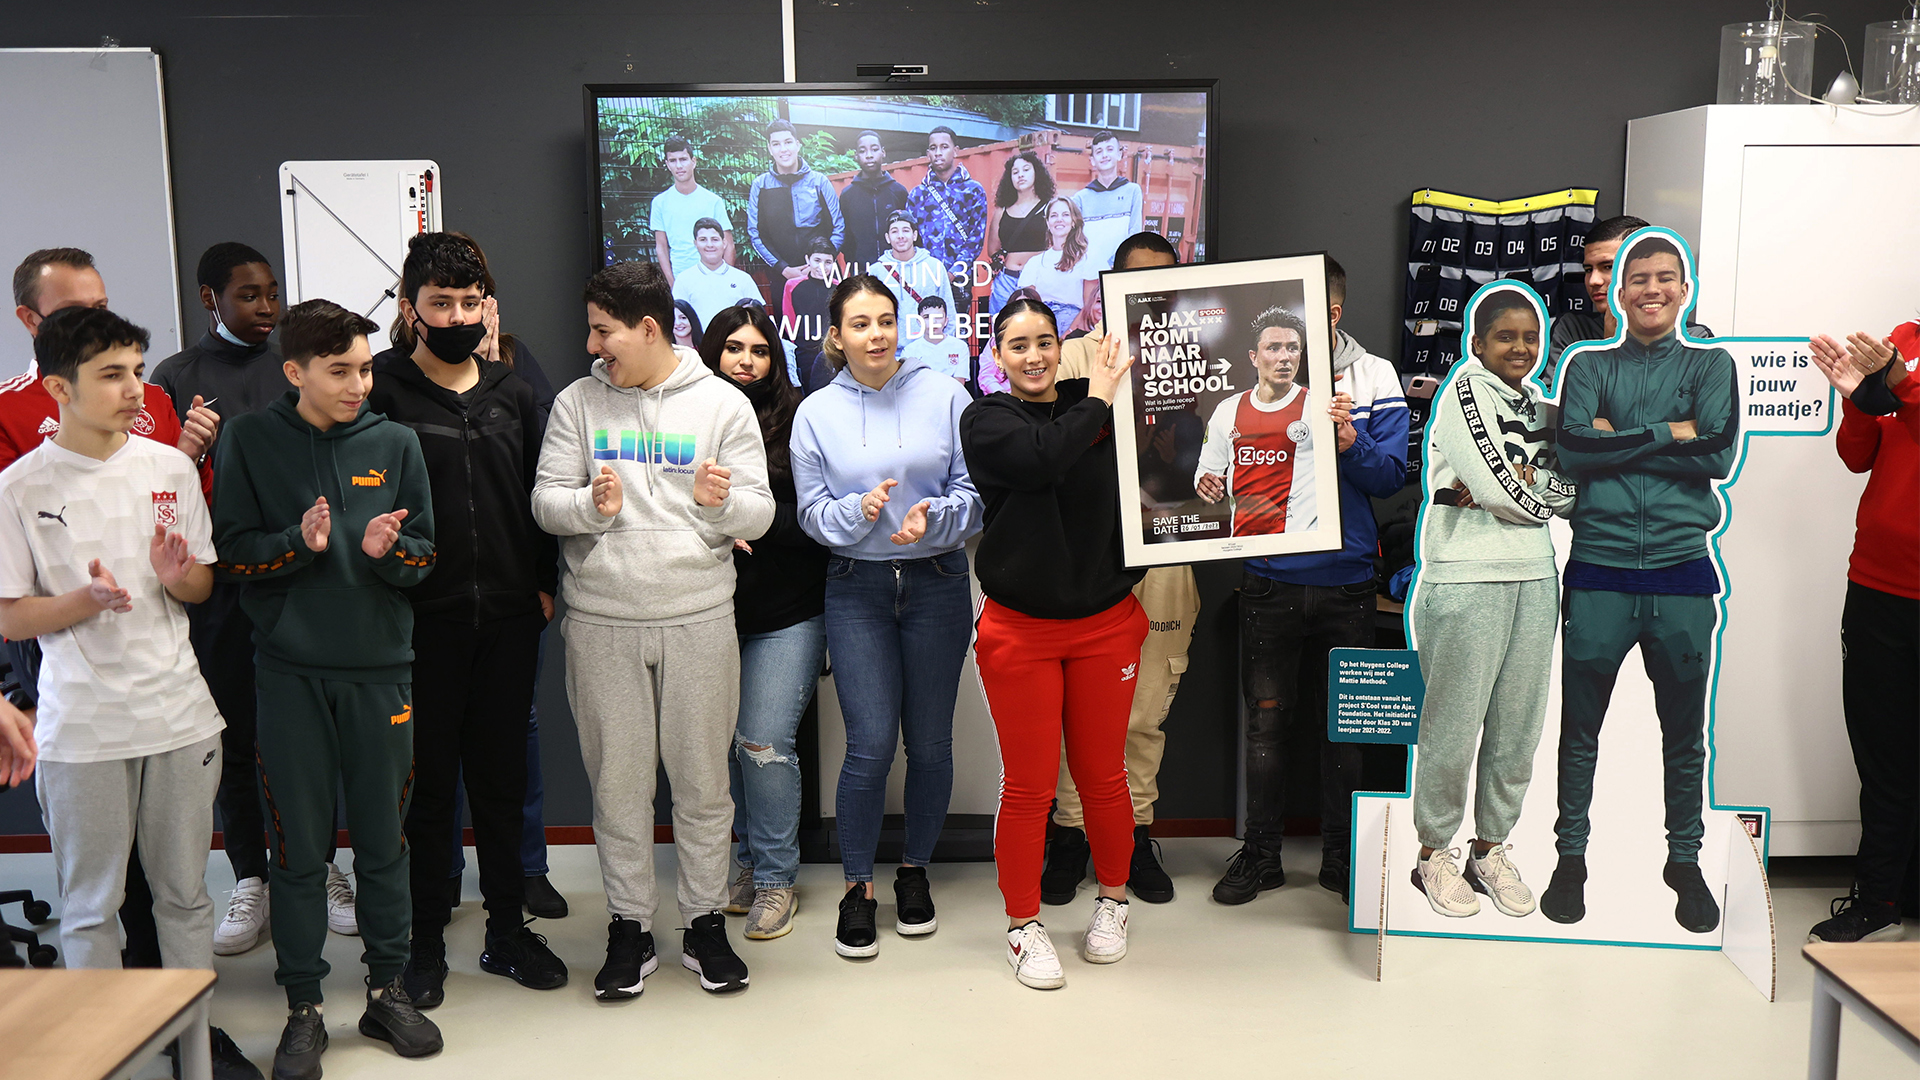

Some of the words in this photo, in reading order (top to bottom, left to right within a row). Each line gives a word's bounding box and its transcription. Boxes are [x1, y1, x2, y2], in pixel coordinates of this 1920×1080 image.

[1422, 240, 1436, 254] 01
[1442, 238, 1460, 252] 02
[1474, 241, 1493, 256] 03
[1507, 240, 1524, 254] 04
[1541, 236, 1558, 252] 05
[882, 261, 942, 288] ZIJN
[952, 260, 993, 288] 3D
[1414, 301, 1430, 314] 07
[1439, 298, 1458, 312] 08
[1569, 298, 1584, 310] 12
[768, 314, 822, 341] WIJ
[906, 314, 944, 339] DE
[1140, 310, 1198, 330] AJAX
[1140, 326, 1202, 348] KOMT
[1141, 344, 1202, 364] NAAR
[1416, 350, 1428, 362] 13
[1440, 352, 1454, 364] 14
[1752, 351, 1786, 368] wie
[1792, 351, 1808, 368] is
[1142, 360, 1208, 382] JOUW
[1144, 374, 1234, 398] SCHOOL
[1749, 375, 1797, 396] jouw
[1748, 400, 1822, 420] maatje?
[352, 476, 381, 486] PUMA
[1153, 516, 1178, 526] SAVE
[1181, 514, 1200, 524] THE
[1154, 524, 1178, 534] DATE
